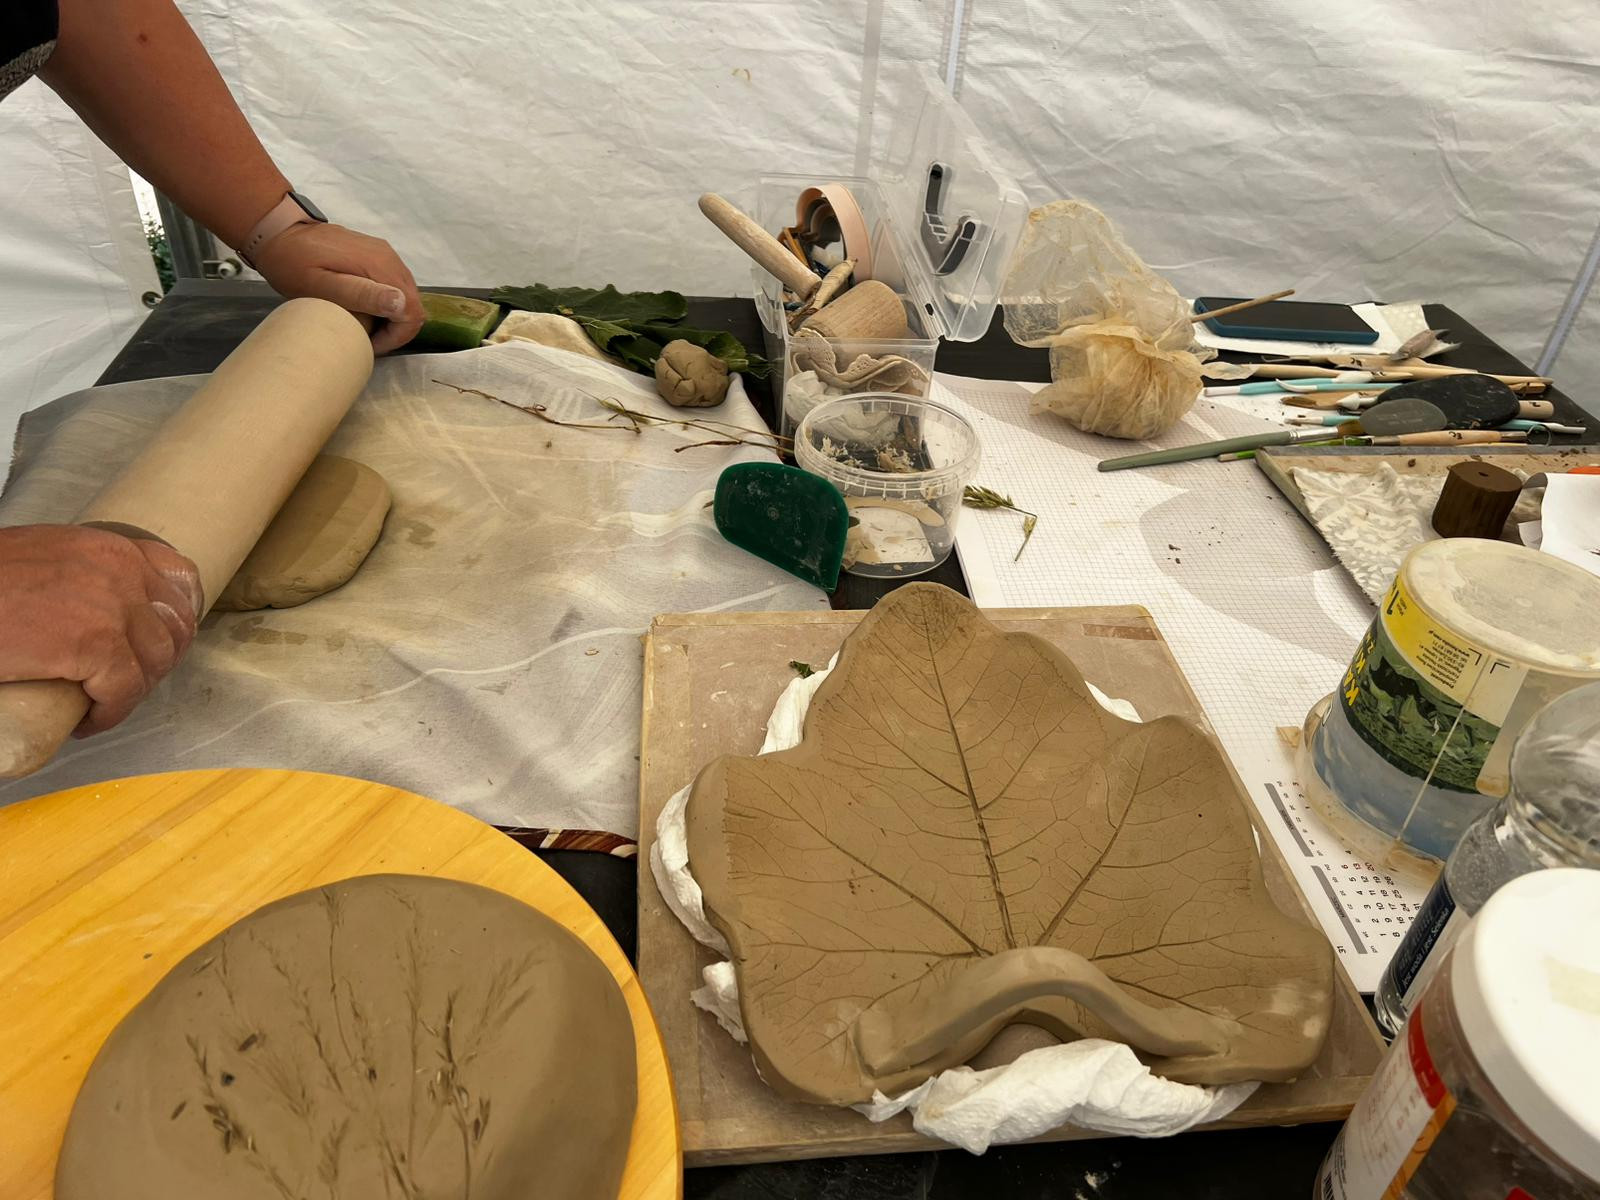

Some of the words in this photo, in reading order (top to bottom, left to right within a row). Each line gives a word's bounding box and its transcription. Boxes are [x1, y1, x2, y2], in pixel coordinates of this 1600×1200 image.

[1364, 862, 1375, 872] 20
[1361, 875, 1369, 883] 12
[1372, 875, 1381, 884] 19
[1384, 875, 1395, 886] 26
[1380, 889, 1389, 897] 18
[1391, 889, 1402, 899] 25
[1376, 902, 1385, 910] 10
[1388, 902, 1397, 910] 17
[1400, 903, 1411, 912] 24
[1396, 916, 1405, 924] 16
[1336, 945, 1347, 954] 31
